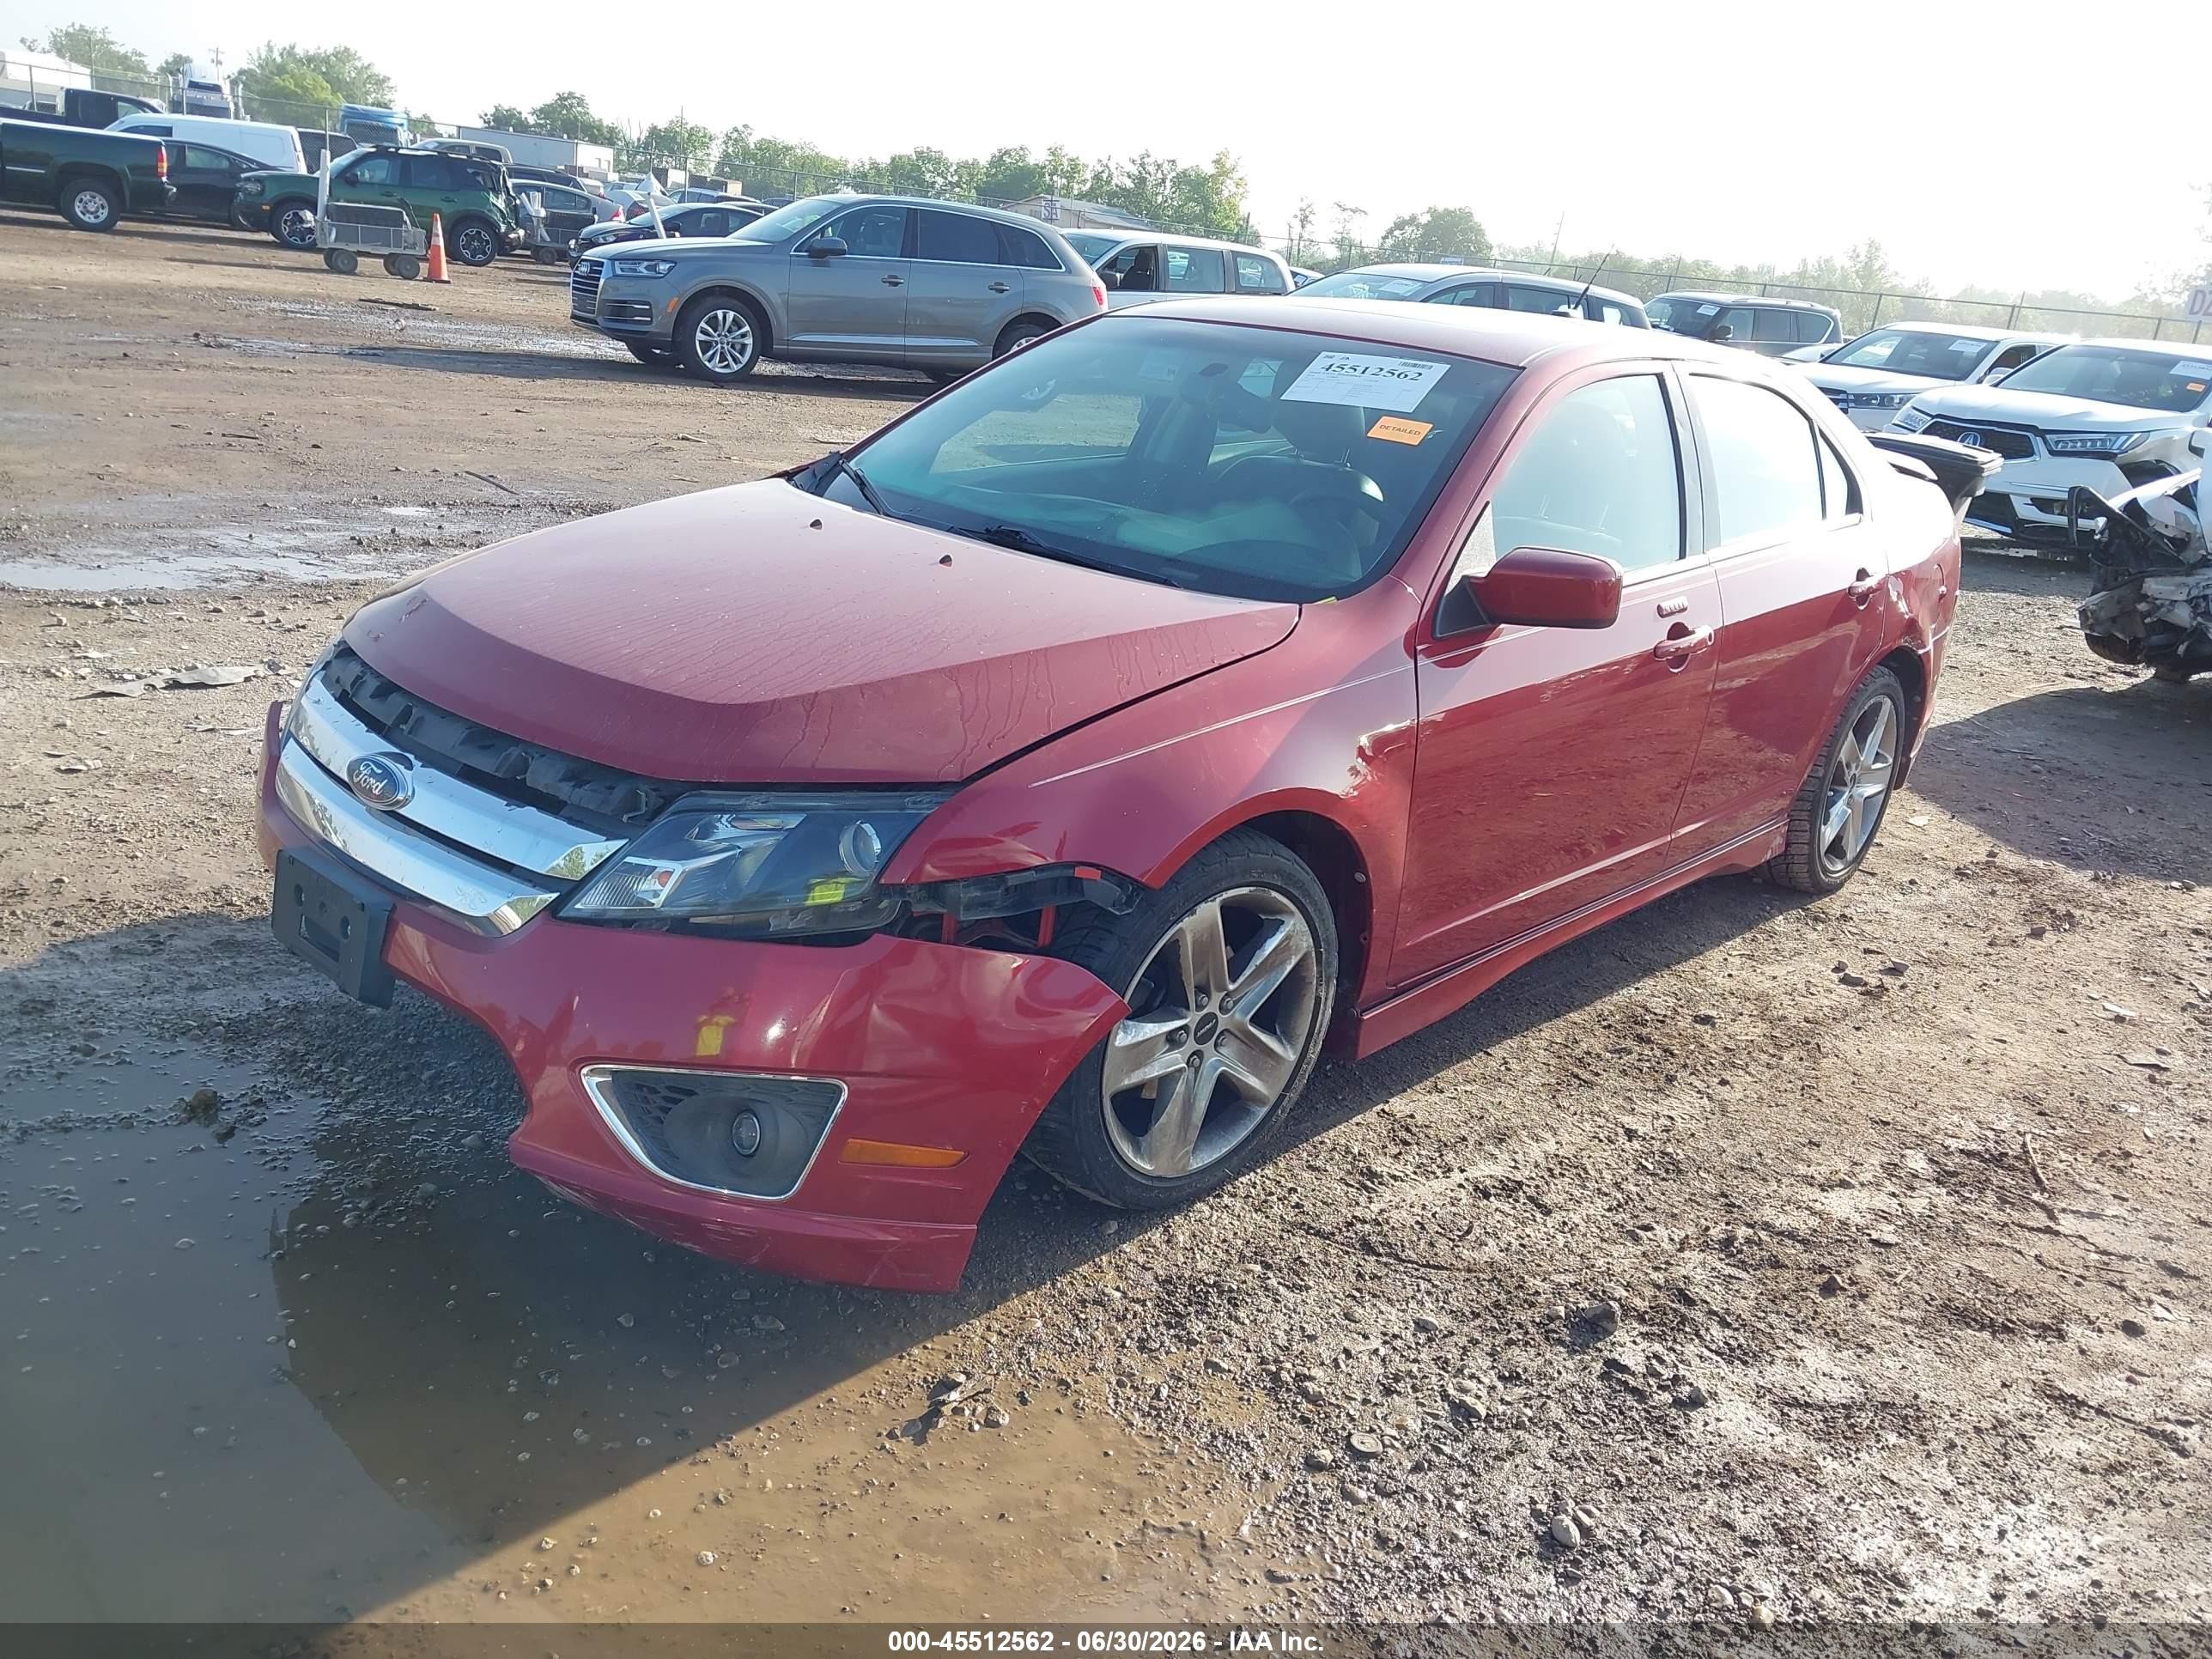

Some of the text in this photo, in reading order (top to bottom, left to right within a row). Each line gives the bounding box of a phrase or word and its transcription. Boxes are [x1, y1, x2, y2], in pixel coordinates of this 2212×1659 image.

[1321, 362, 1424, 381] 45512562
[1379, 424, 1421, 436] DETAILED
[352, 761, 388, 796] Ford
